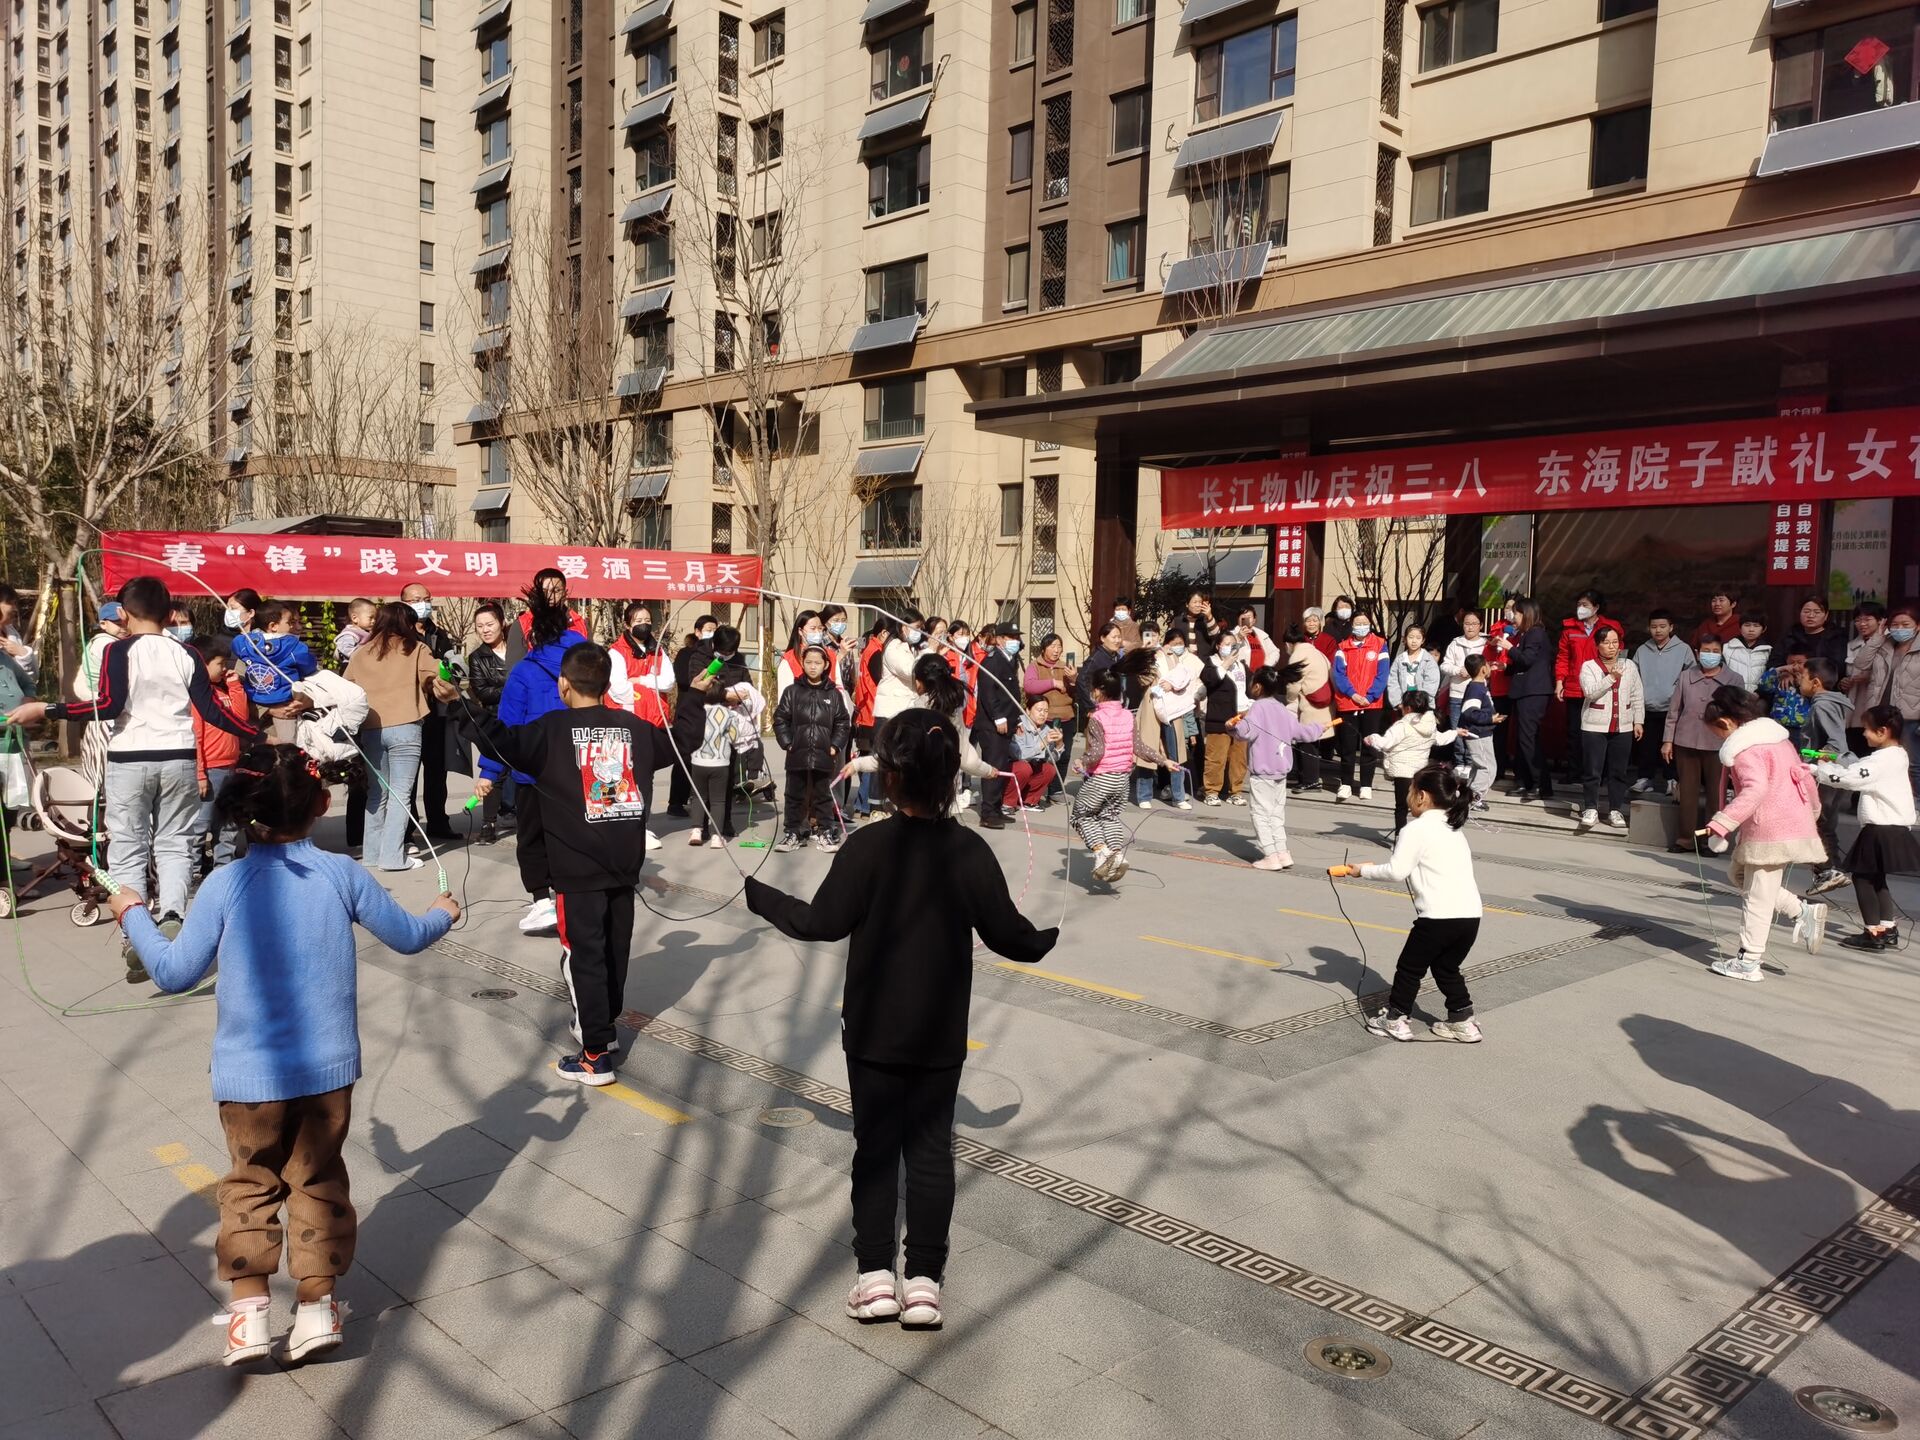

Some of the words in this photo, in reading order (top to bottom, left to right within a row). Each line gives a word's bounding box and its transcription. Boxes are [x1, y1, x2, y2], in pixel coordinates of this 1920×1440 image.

[1199, 457, 1487, 517] 长江物业庆祝三·八
[162, 542, 499, 577] 春“锋”践文明
[556, 555, 741, 585] 爱洒三月天
[1278, 526, 1290, 577] 道德底线
[1291, 525, 1302, 577] 纪律底线
[1773, 504, 1791, 570] 自我提高
[1794, 503, 1812, 570] 自我完善
